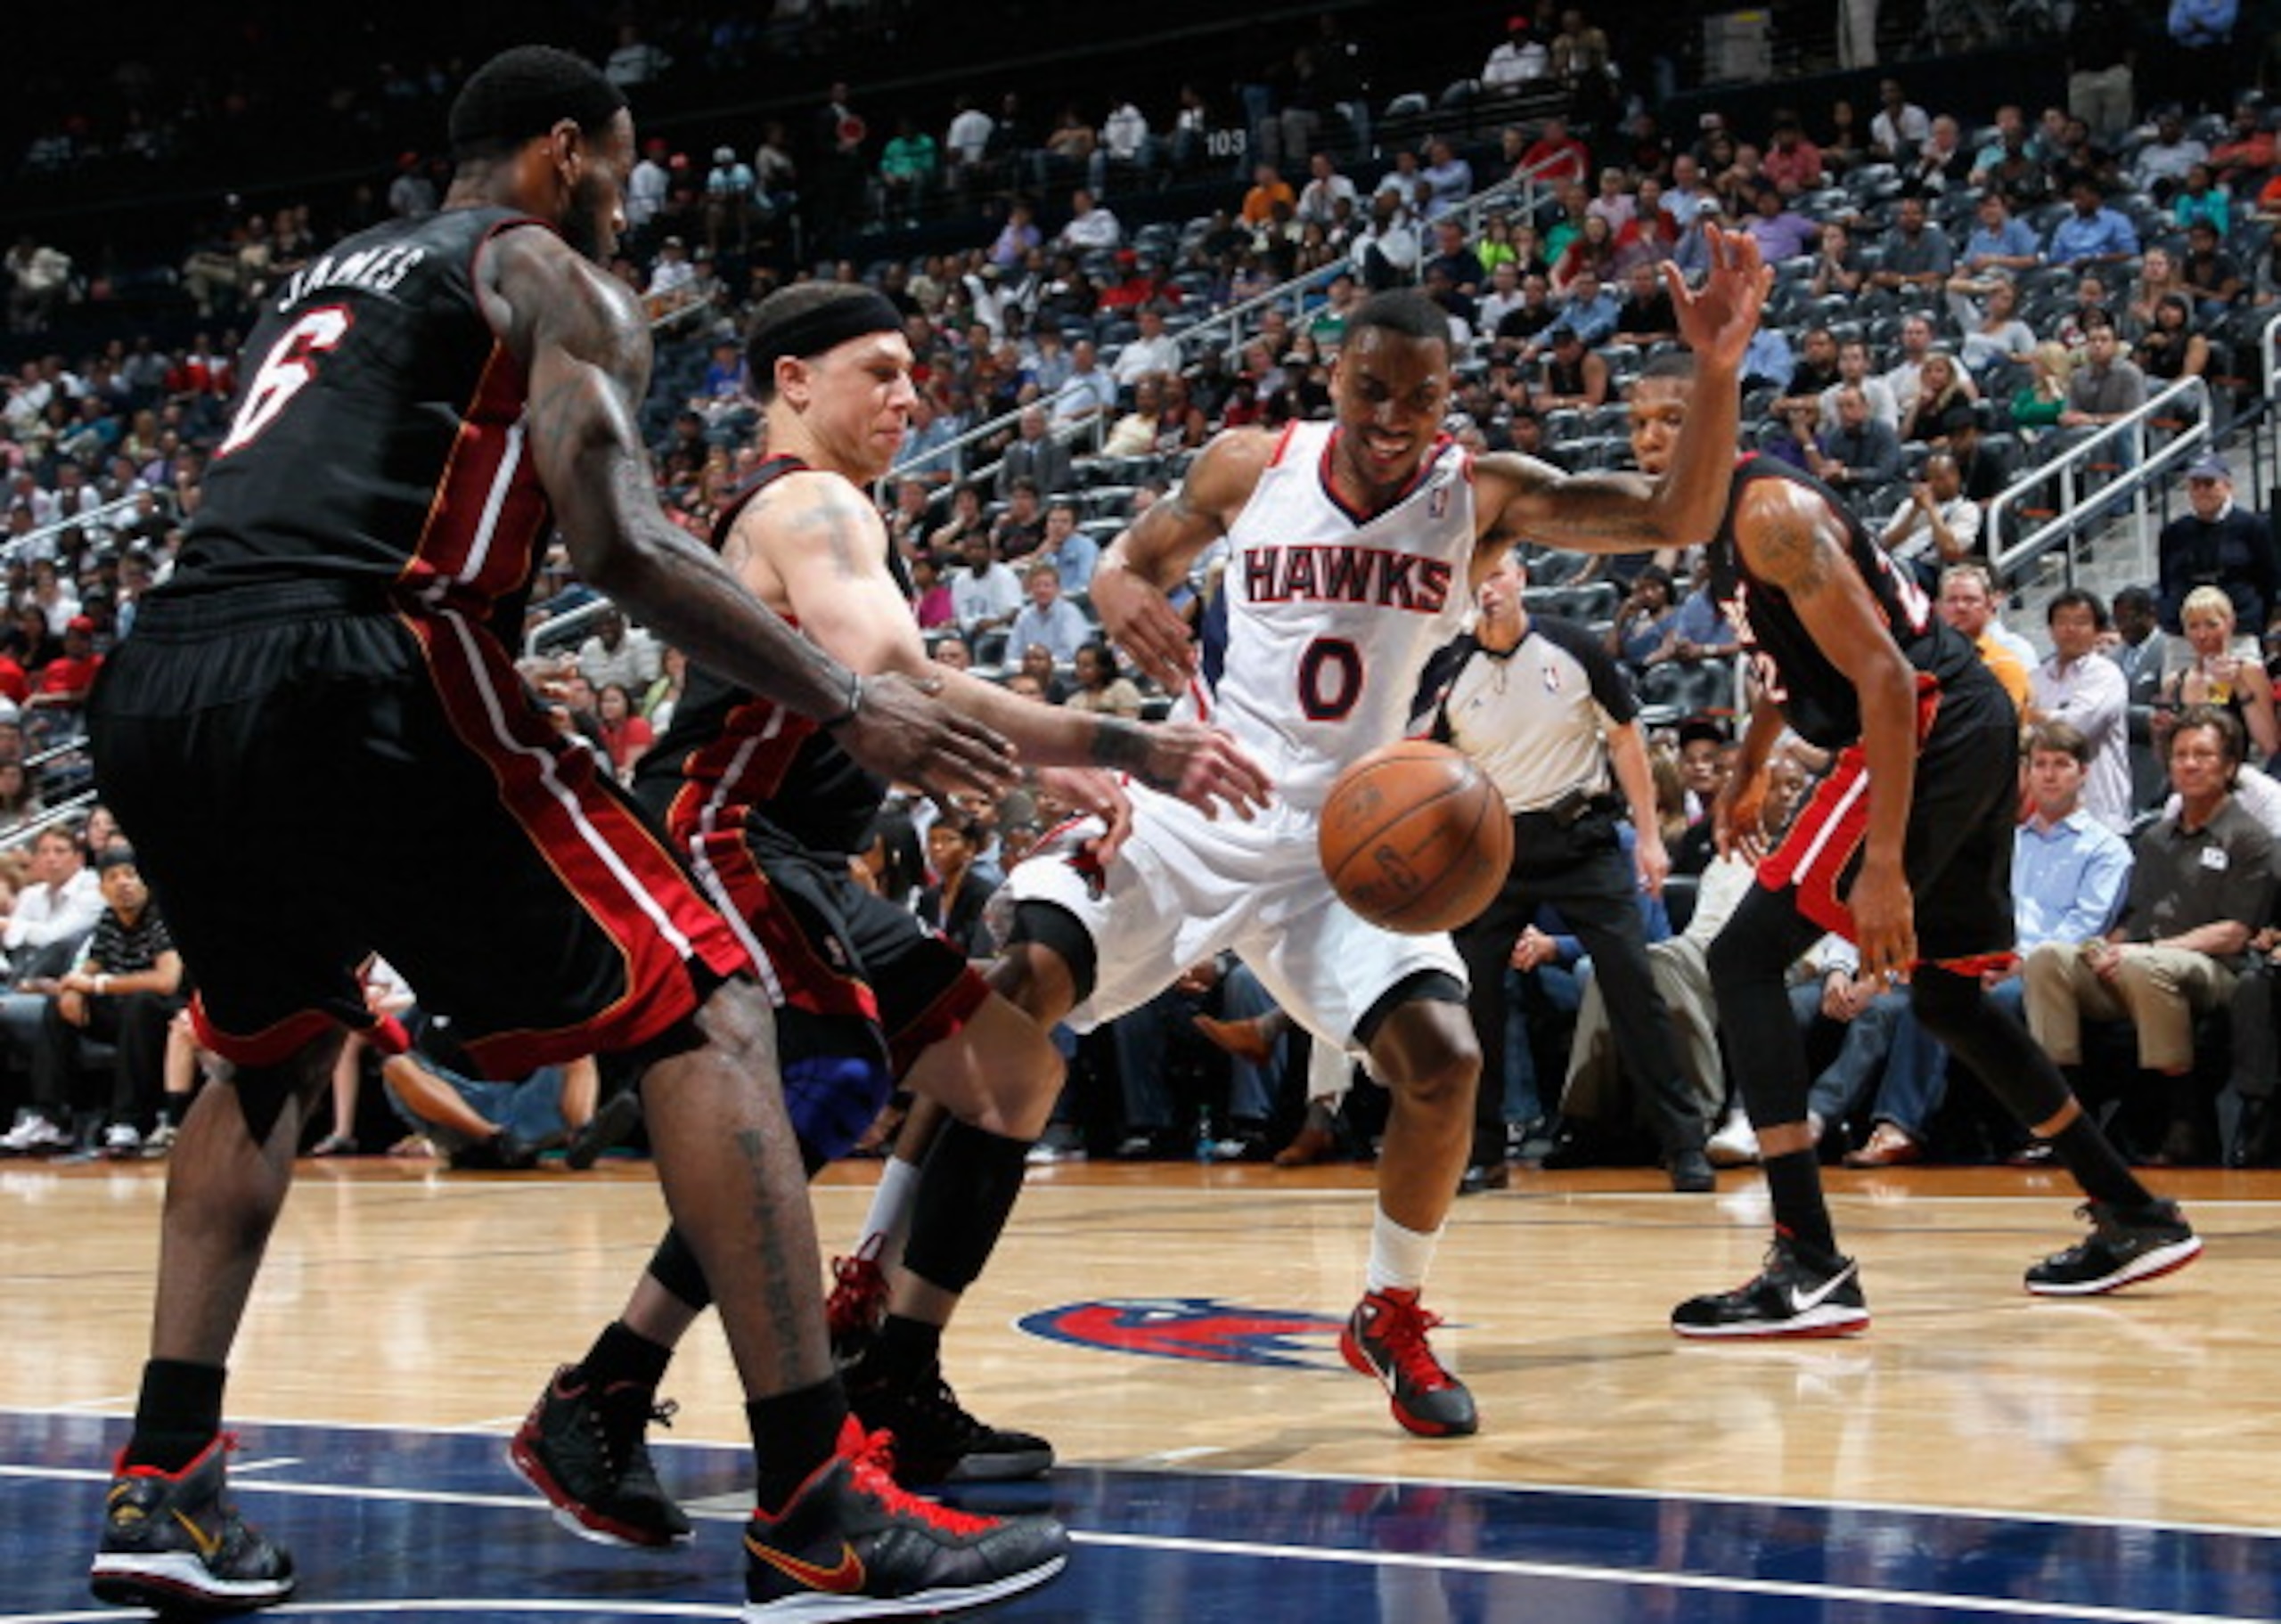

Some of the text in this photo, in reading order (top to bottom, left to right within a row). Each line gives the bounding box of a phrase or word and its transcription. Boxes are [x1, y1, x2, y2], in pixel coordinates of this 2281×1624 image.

[1206, 128, 1247, 156] 103
[278, 246, 424, 313] JAMES
[212, 303, 356, 460] 6
[1245, 543, 1453, 615] HAWKS
[1297, 637, 1365, 722] 0
